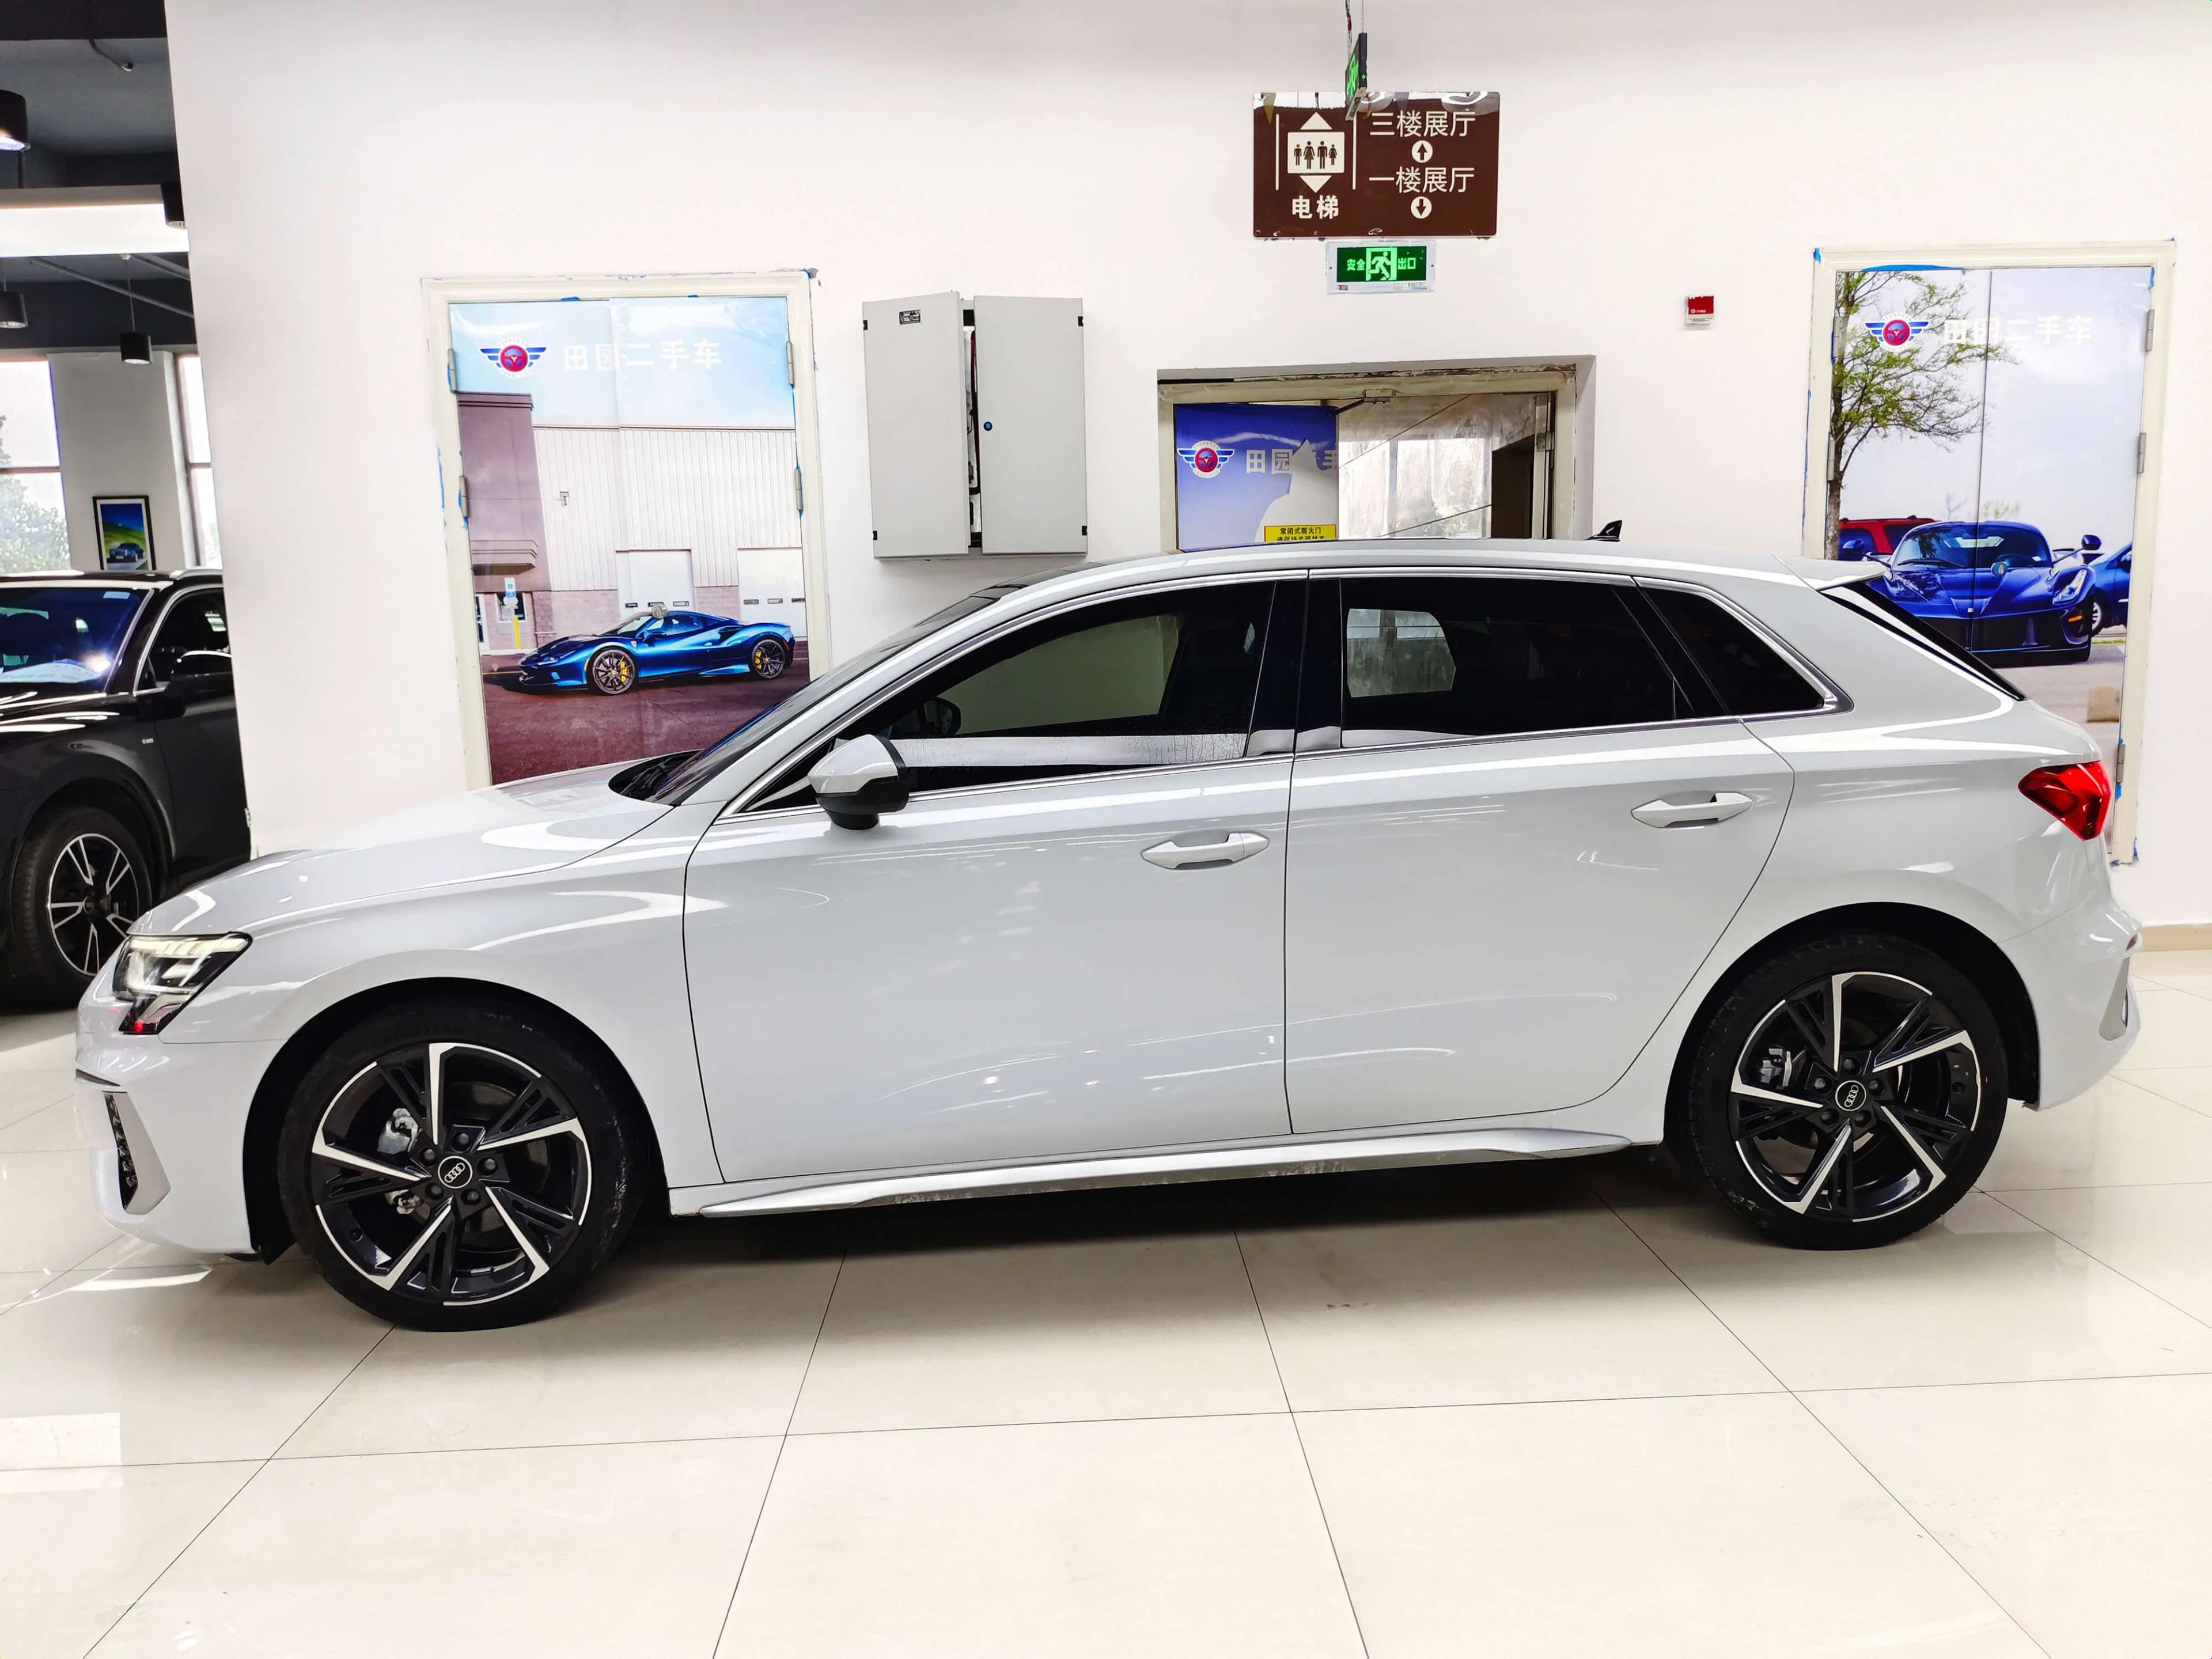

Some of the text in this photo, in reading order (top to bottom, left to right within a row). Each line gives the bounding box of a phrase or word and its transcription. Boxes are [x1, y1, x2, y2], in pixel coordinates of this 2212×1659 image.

[1370, 111, 1476, 137] 三楼展厅
[1369, 166, 1475, 194] 一楼展厅
[1292, 196, 1339, 219] 电梯
[1347, 257, 1416, 271] 安全 出口
[1246, 449, 1338, 475] 田园
[1280, 527, 1321, 535] 常闭式防火门
